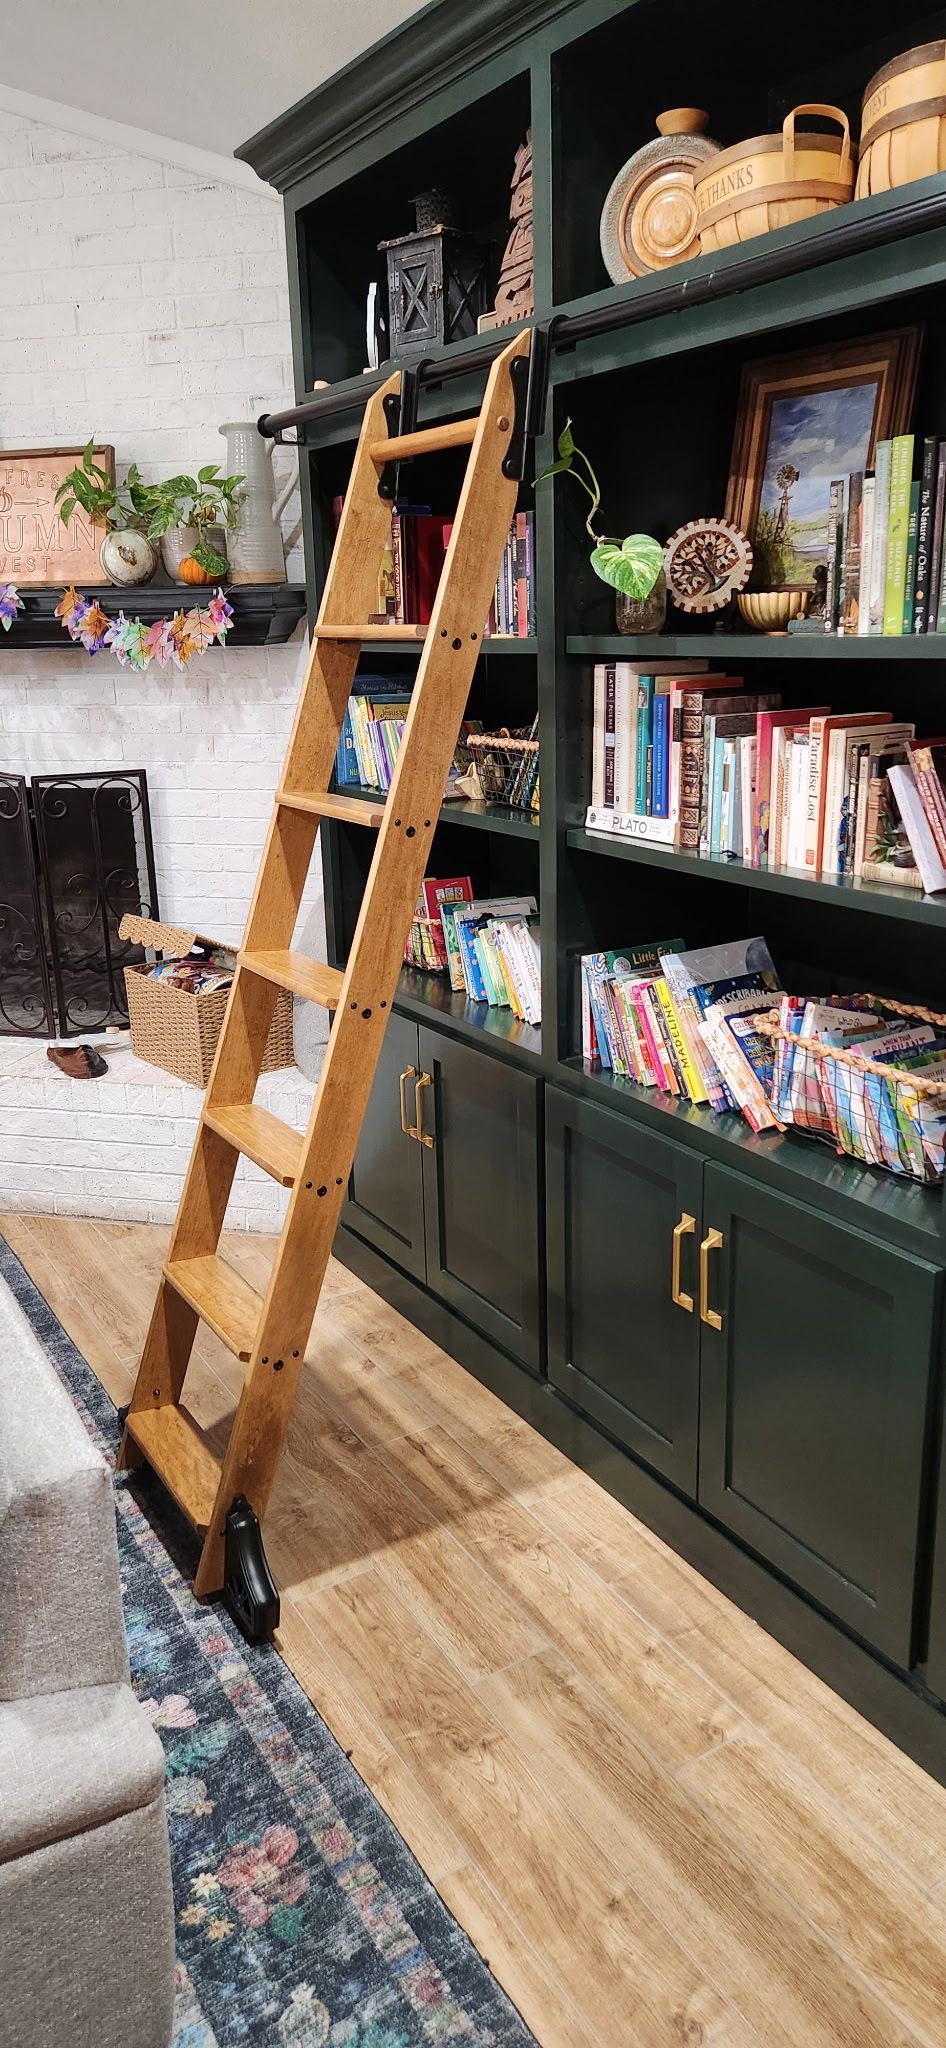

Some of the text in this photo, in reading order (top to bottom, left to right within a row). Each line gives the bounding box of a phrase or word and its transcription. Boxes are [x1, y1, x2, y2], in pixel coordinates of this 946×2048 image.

[707, 164, 754, 207] THANKS
[890, 443, 900, 513] MOTHER TREE
[899, 441, 909, 507] FINDING THE
[909, 512, 917, 537] TREES
[917, 490, 930, 582] The Nature of Oaks
[887, 541, 895, 581] SIMARD
[894, 541, 903, 588] SUZANNE
[807, 737, 821, 822] Paradise Lost
[612, 816, 648, 834] PLATO
[632, 950, 656, 965] Little
[663, 1001, 691, 1069] MADELINE
